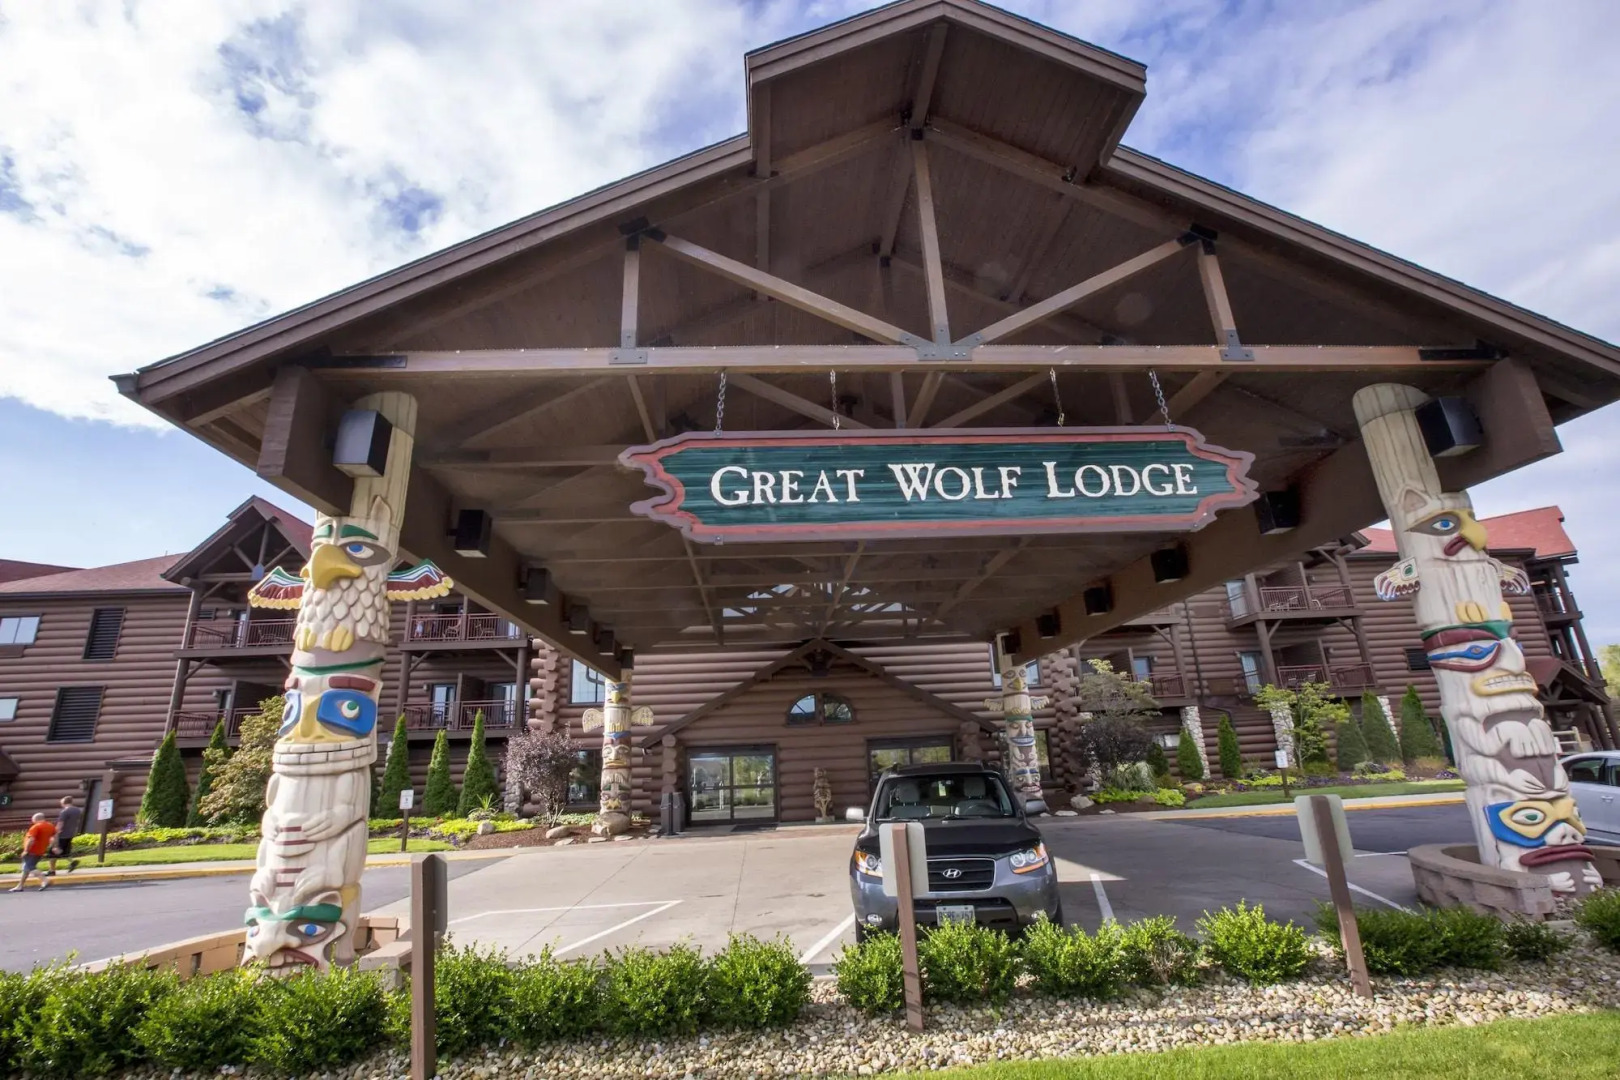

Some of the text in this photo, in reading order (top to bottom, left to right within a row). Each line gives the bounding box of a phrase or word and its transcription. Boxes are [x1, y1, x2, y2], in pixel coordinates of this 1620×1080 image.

[710, 461, 1199, 506] GREAT WOLF LODGE
